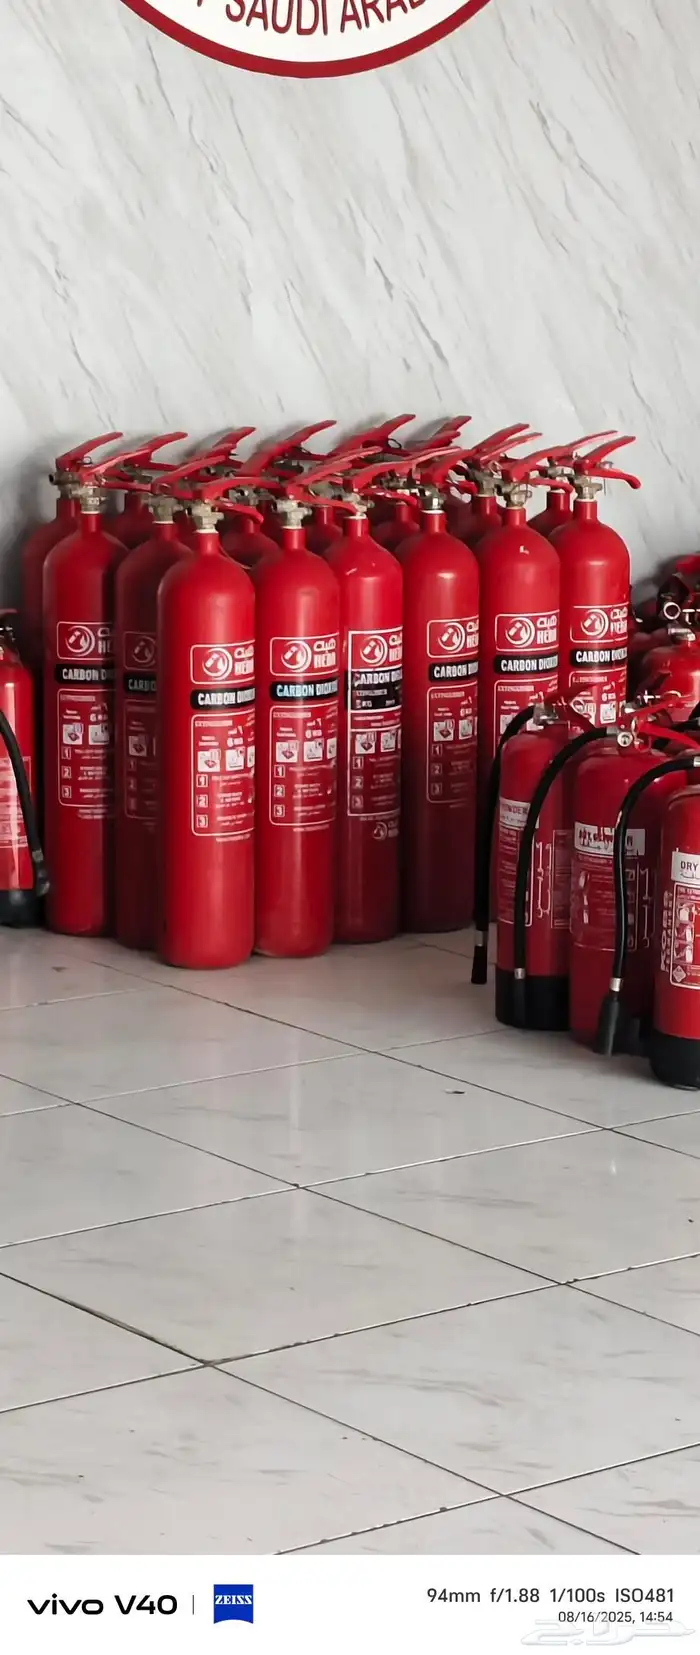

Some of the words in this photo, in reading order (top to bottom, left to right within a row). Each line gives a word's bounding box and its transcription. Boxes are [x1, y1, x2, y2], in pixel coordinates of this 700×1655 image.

[226, 0, 328, 35] SAUDI
[576, 650, 611, 663] CARBON
[433, 665, 467, 678] CARBON
[501, 659, 537, 671] CARBON
[62, 669, 99, 681] CARBON
[276, 684, 314, 698] CARBON
[197, 691, 235, 706] CARBON
[680, 861, 699, 871] DRY
